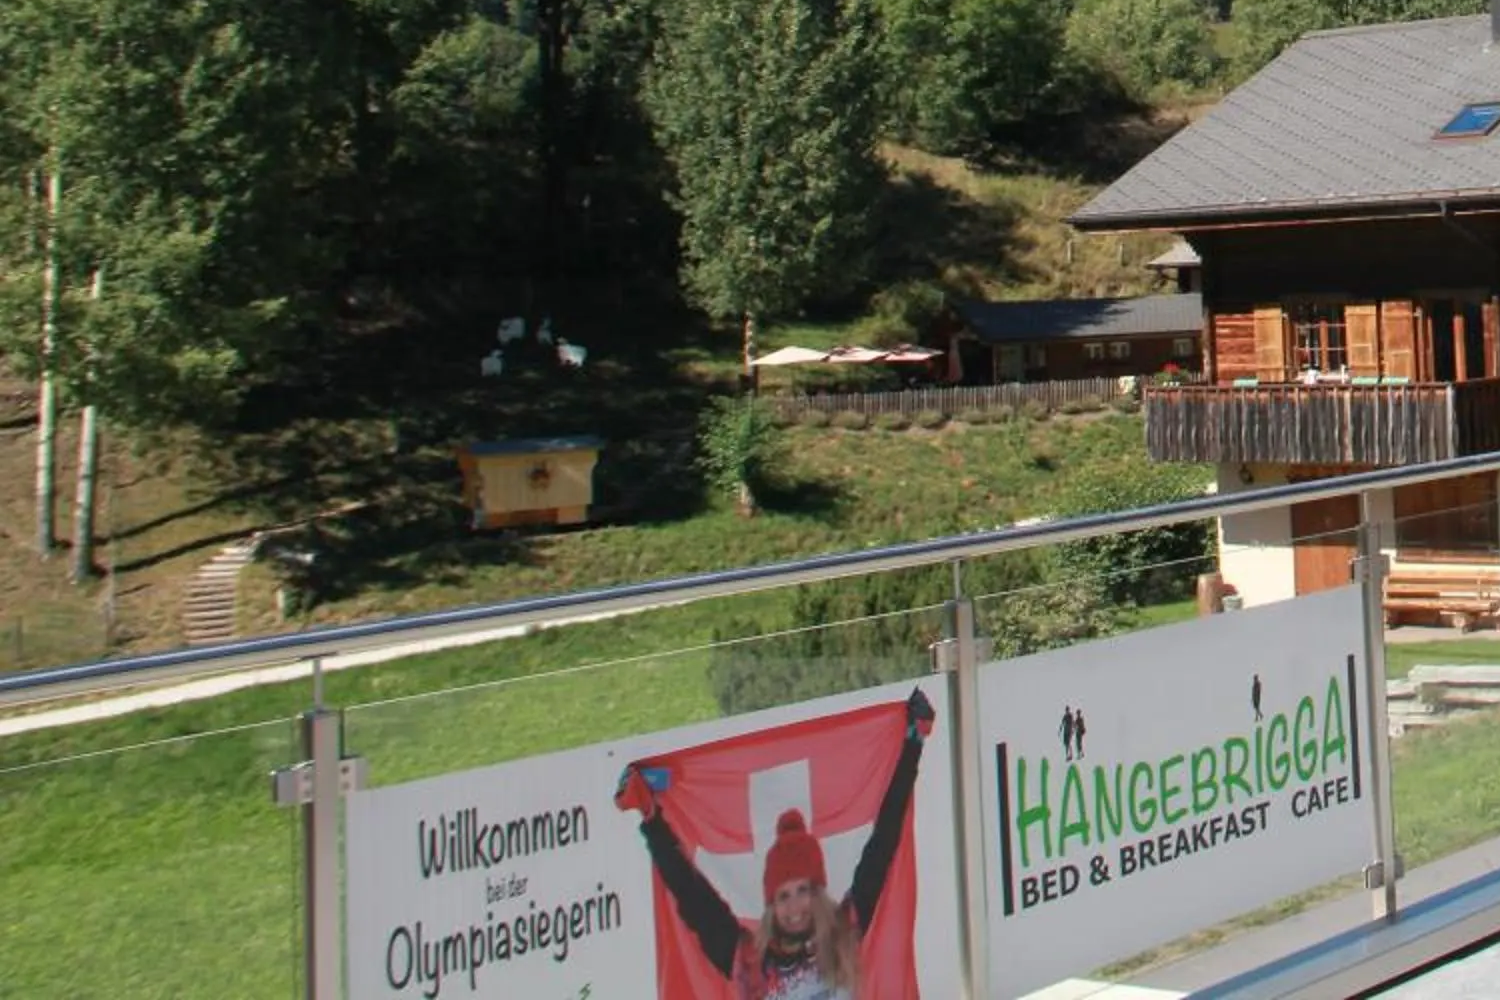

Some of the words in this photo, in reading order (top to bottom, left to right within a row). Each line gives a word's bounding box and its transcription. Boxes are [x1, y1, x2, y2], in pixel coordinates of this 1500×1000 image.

[419, 807, 589, 879] Willkommen
[486, 879, 505, 905] bei
[507, 872, 529, 899] der
[1021, 864, 1080, 909] BED
[1089, 855, 1112, 886] &
[1120, 802, 1271, 878] BREAKFAST
[1291, 776, 1350, 818] CAFE
[386, 882, 622, 999] Olympiasiegerin
